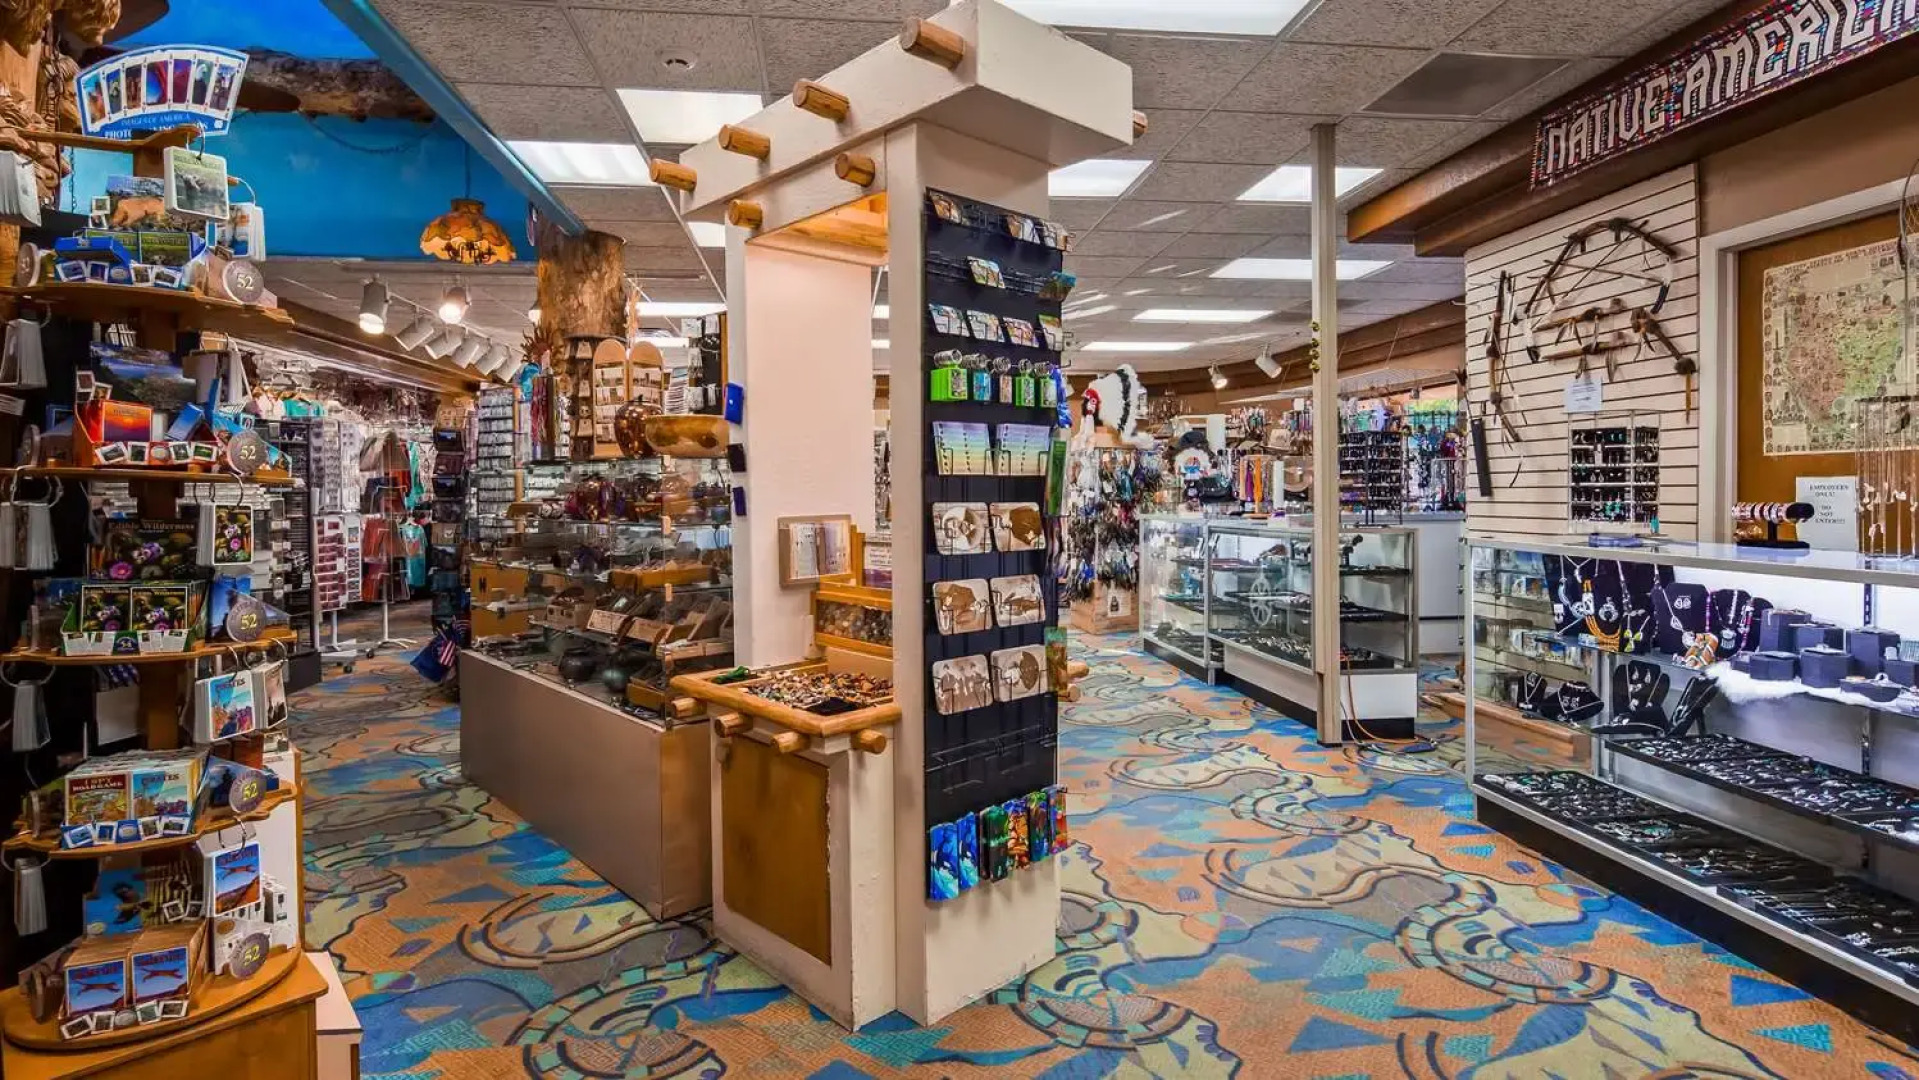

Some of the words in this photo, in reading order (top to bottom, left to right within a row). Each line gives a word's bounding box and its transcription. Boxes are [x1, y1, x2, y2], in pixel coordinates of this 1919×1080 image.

[1546, 72, 1670, 174] NATIVE
[236, 272, 254, 290] 52
[240, 445, 256, 460] 52
[143, 522, 195, 531] Wilderness
[240, 613, 257, 630] 52
[242, 780, 257, 800] 52
[244, 943, 261, 966] 52
